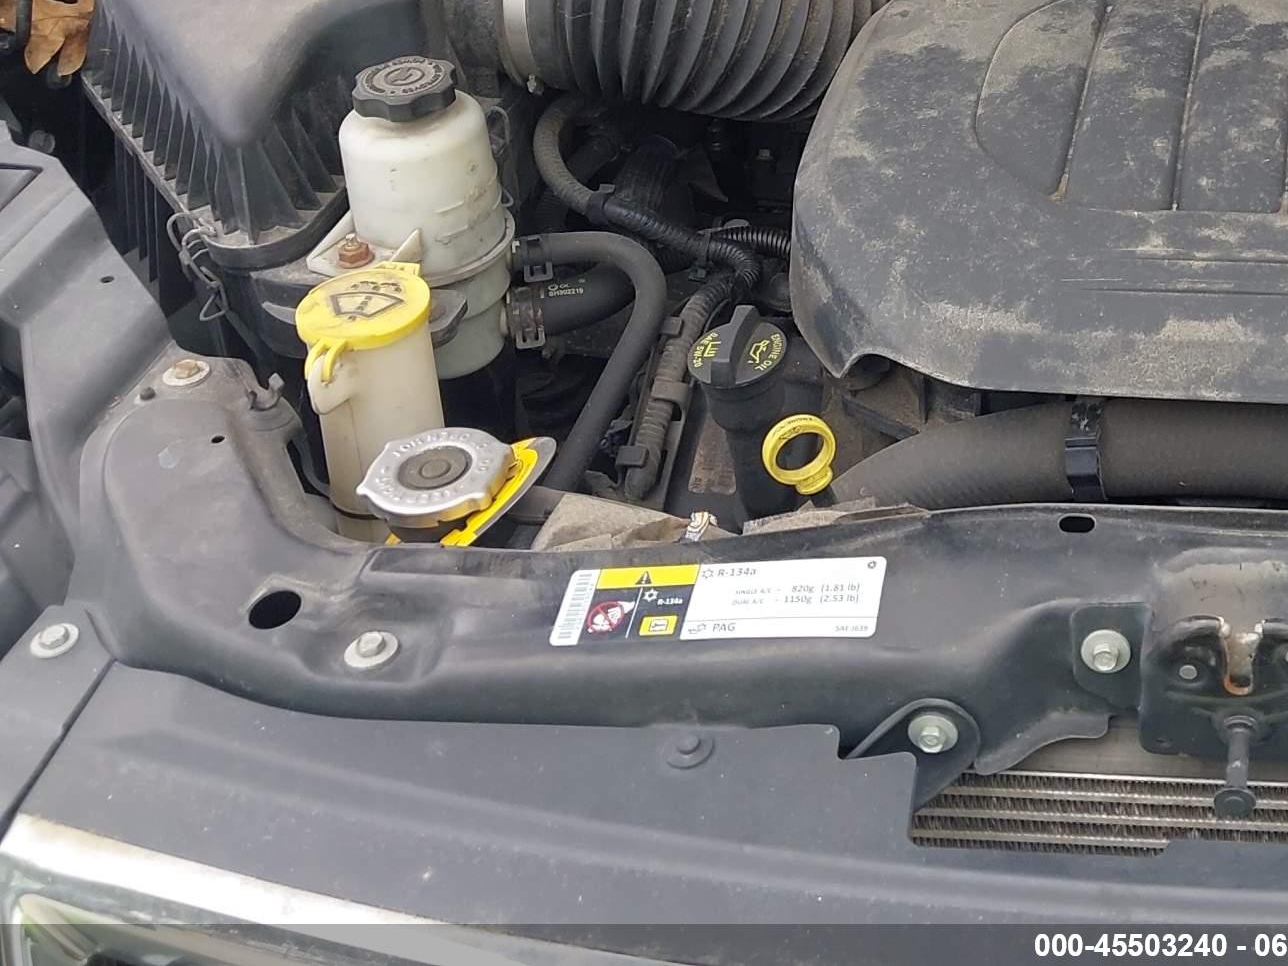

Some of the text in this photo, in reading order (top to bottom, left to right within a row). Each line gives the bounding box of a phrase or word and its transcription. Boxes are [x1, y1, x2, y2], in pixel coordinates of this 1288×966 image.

[754, 333, 784, 371] ENGINE OIL
[717, 568, 758, 578] R-134a
[791, 584, 816, 594] 820g
[847, 582, 860, 593] lb)
[657, 598, 684, 606] R-134a
[784, 594, 812, 604] 1150g
[819, 594, 844, 604] (2.53
[846, 593, 860, 604] lb)
[712, 623, 737, 633] PAG
